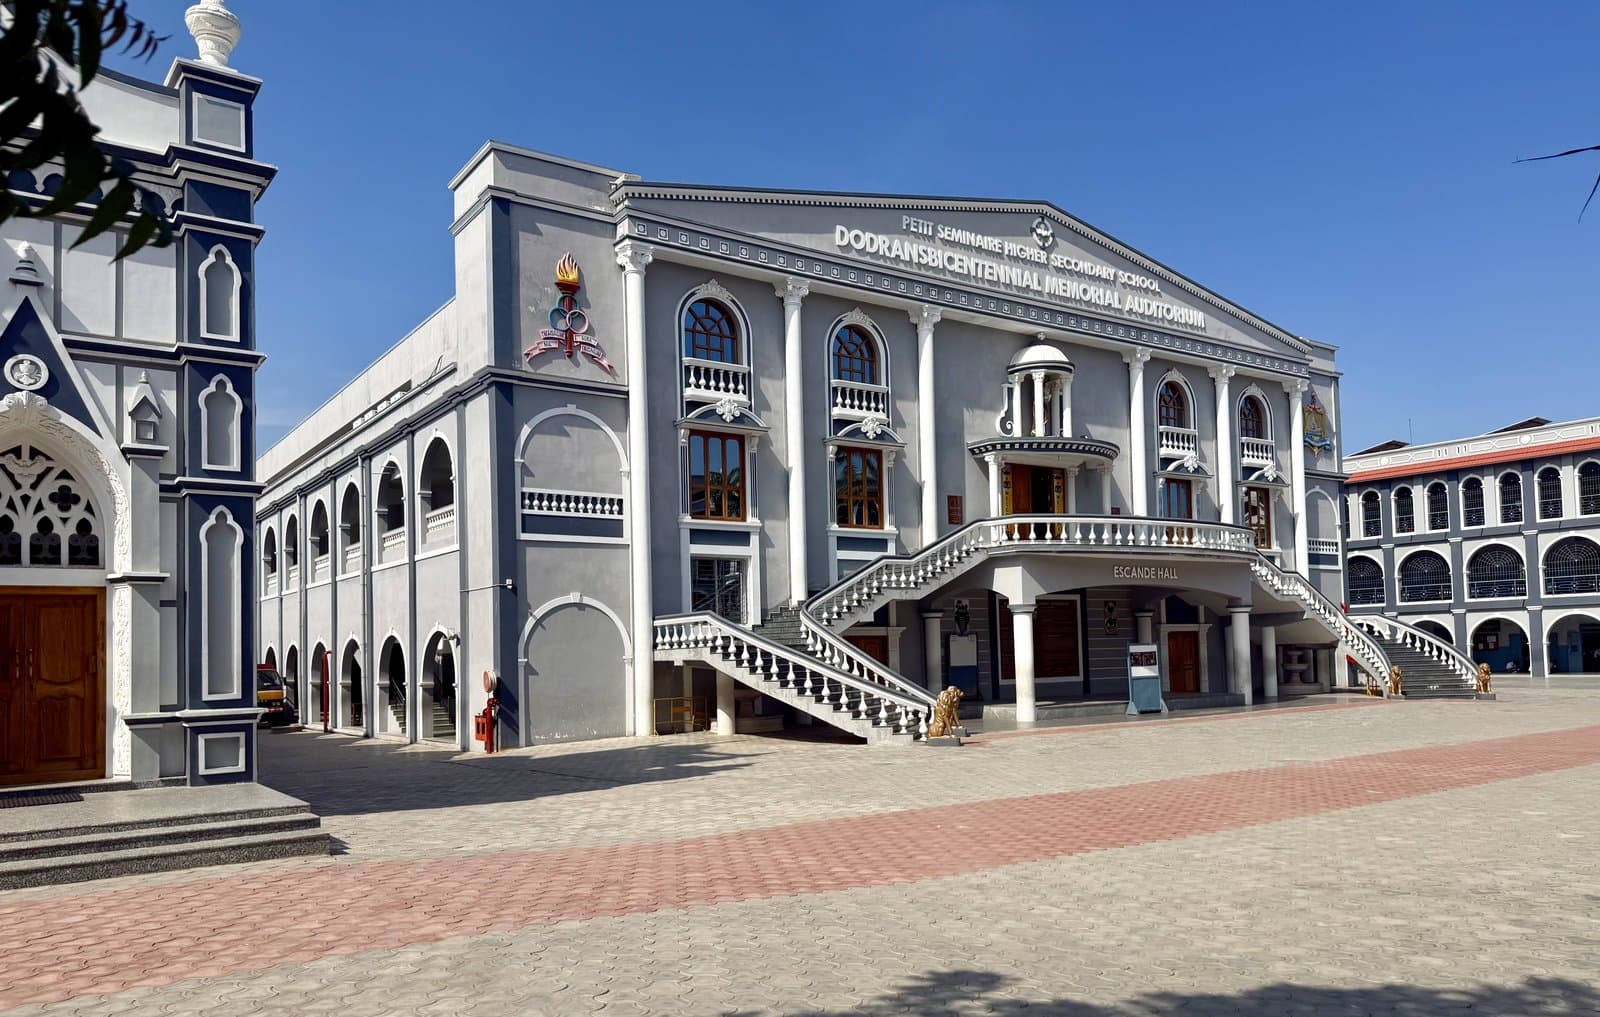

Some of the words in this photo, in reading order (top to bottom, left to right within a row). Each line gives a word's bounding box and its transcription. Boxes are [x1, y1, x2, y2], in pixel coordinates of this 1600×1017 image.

[902, 215, 934, 236] PETIT
[937, 224, 1002, 253] SEMINAIRE
[1004, 241, 1048, 264] HIGHER
[1051, 253, 1116, 281] SECONDARY
[1119, 270, 1161, 292] SCHOOL
[1045, 275, 1122, 309] MEMORIAL
[1125, 295, 1206, 328] AUDITORIUM
[1113, 566, 1156, 579] ESCANDE
[1157, 567, 1179, 580] HALL
